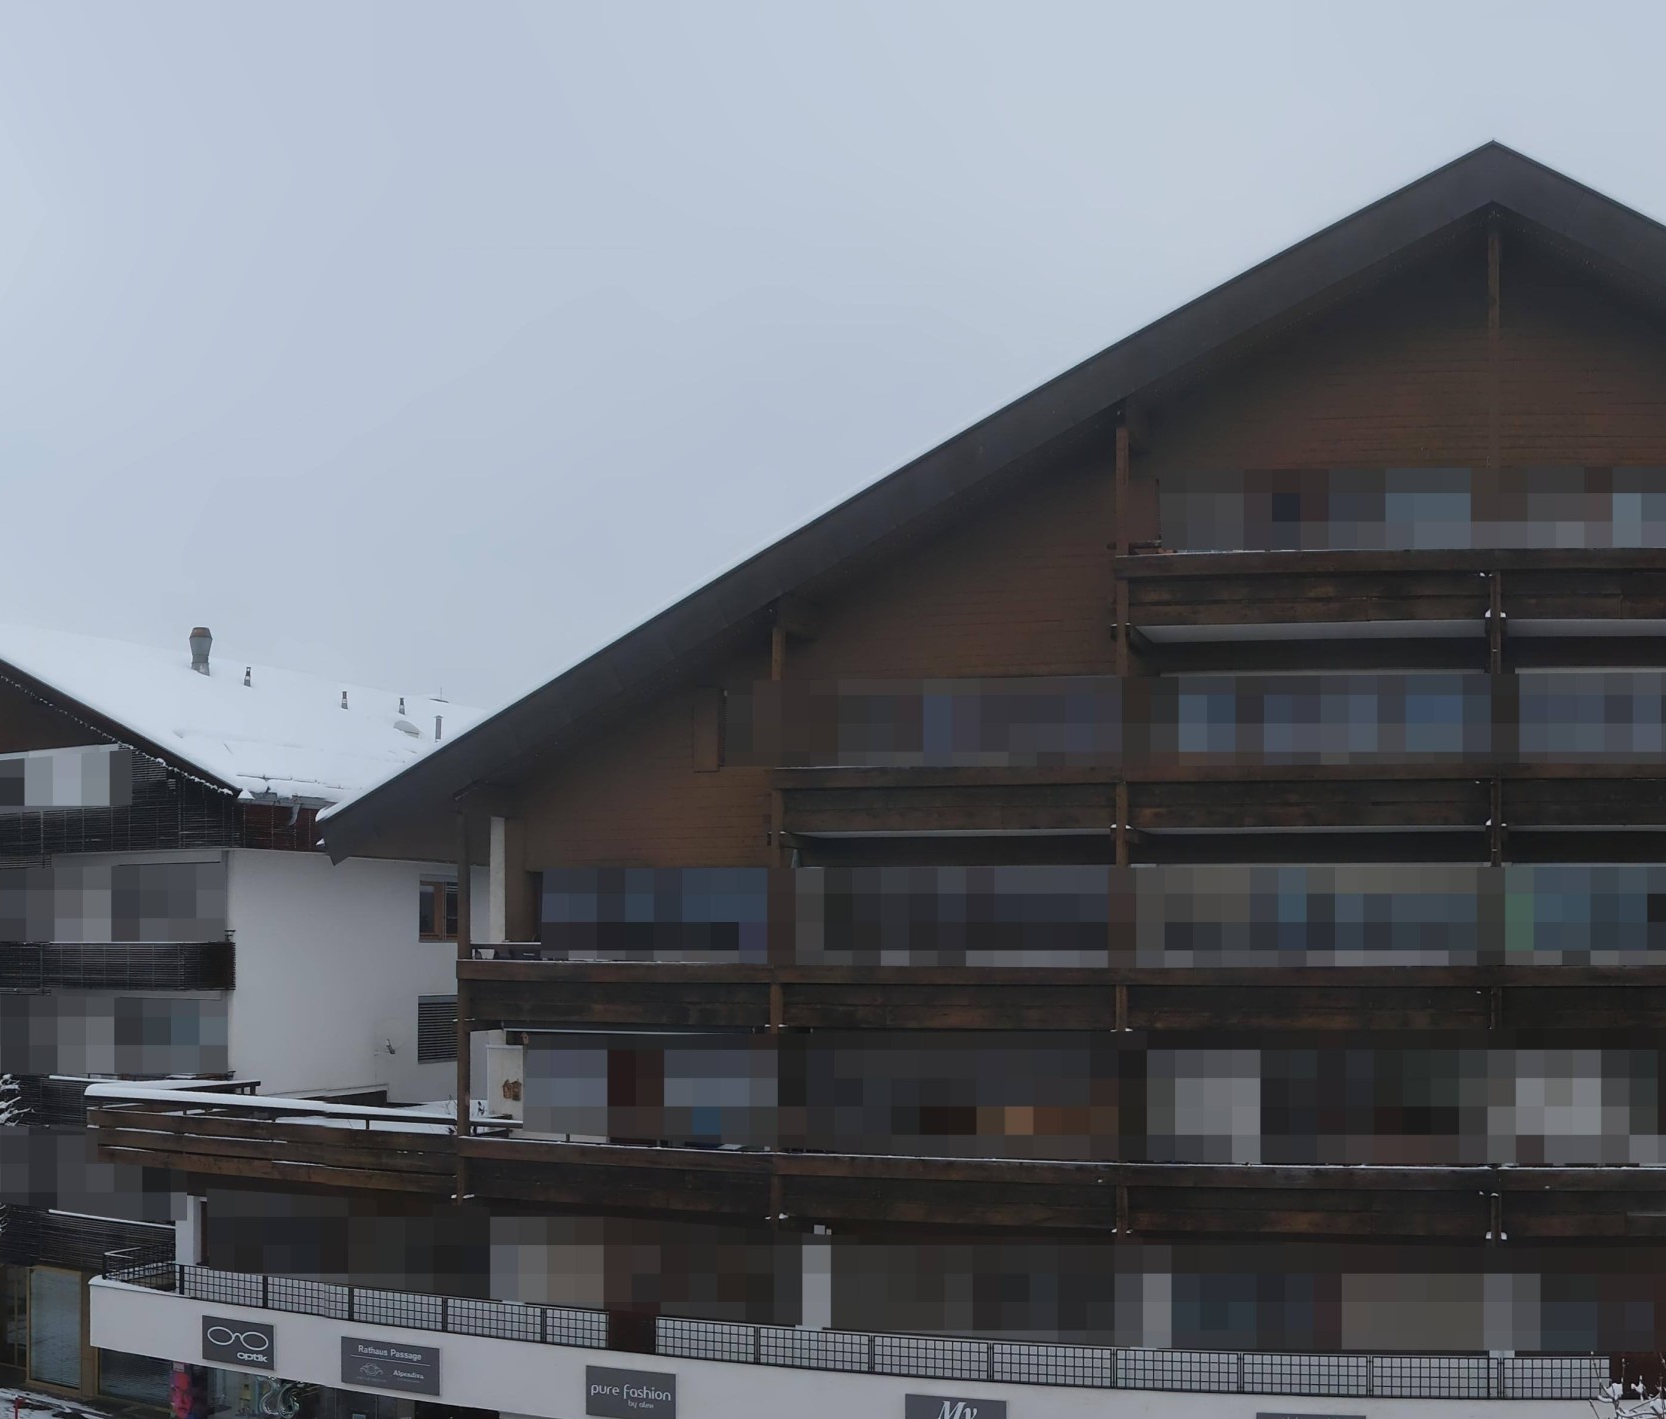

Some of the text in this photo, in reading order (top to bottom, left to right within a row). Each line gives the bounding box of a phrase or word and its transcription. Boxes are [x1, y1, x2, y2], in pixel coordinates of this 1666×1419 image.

[236, 1352, 268, 1363] optik
[358, 1344, 422, 1361] Rathaus Passage
[591, 1384, 671, 1401] pure fashion
[627, 1399, 638, 1409] by
